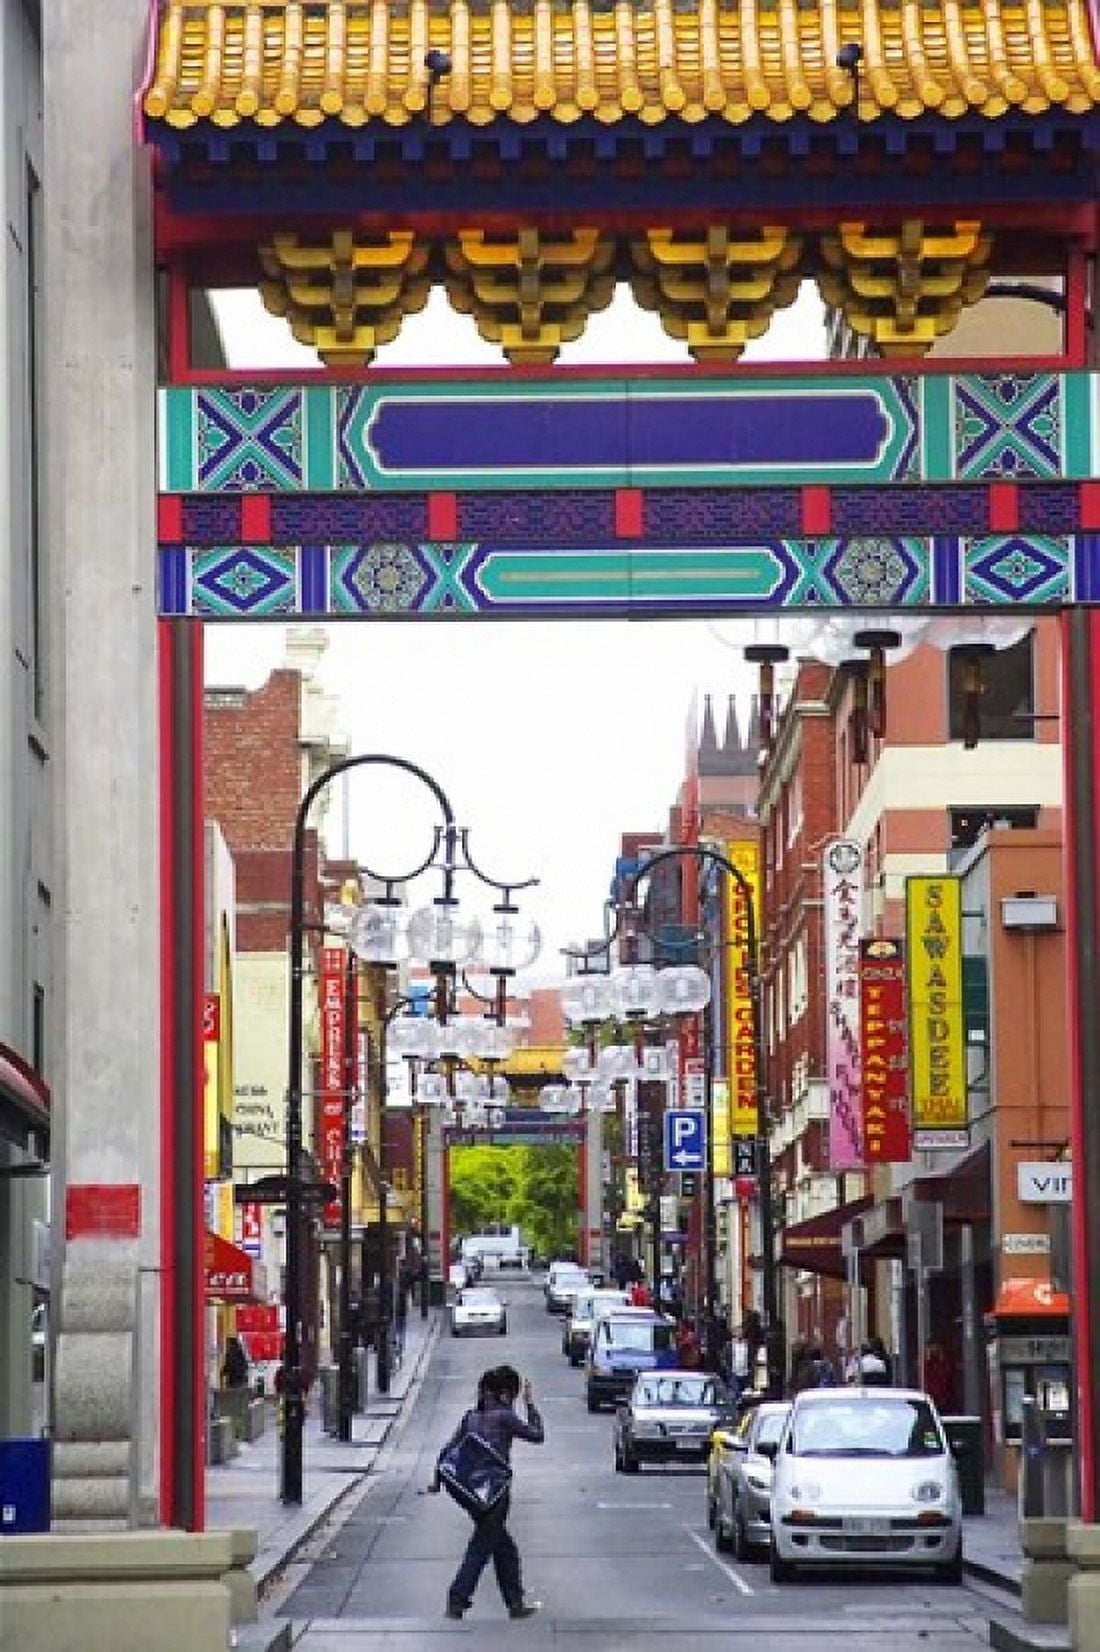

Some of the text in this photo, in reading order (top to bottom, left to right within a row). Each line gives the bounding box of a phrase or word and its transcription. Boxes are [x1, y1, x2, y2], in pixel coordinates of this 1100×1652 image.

[867, 986, 887, 1152] TEPPANYAKI
[921, 886, 950, 1096] SAWASDEE
[675, 1117, 698, 1147] P
